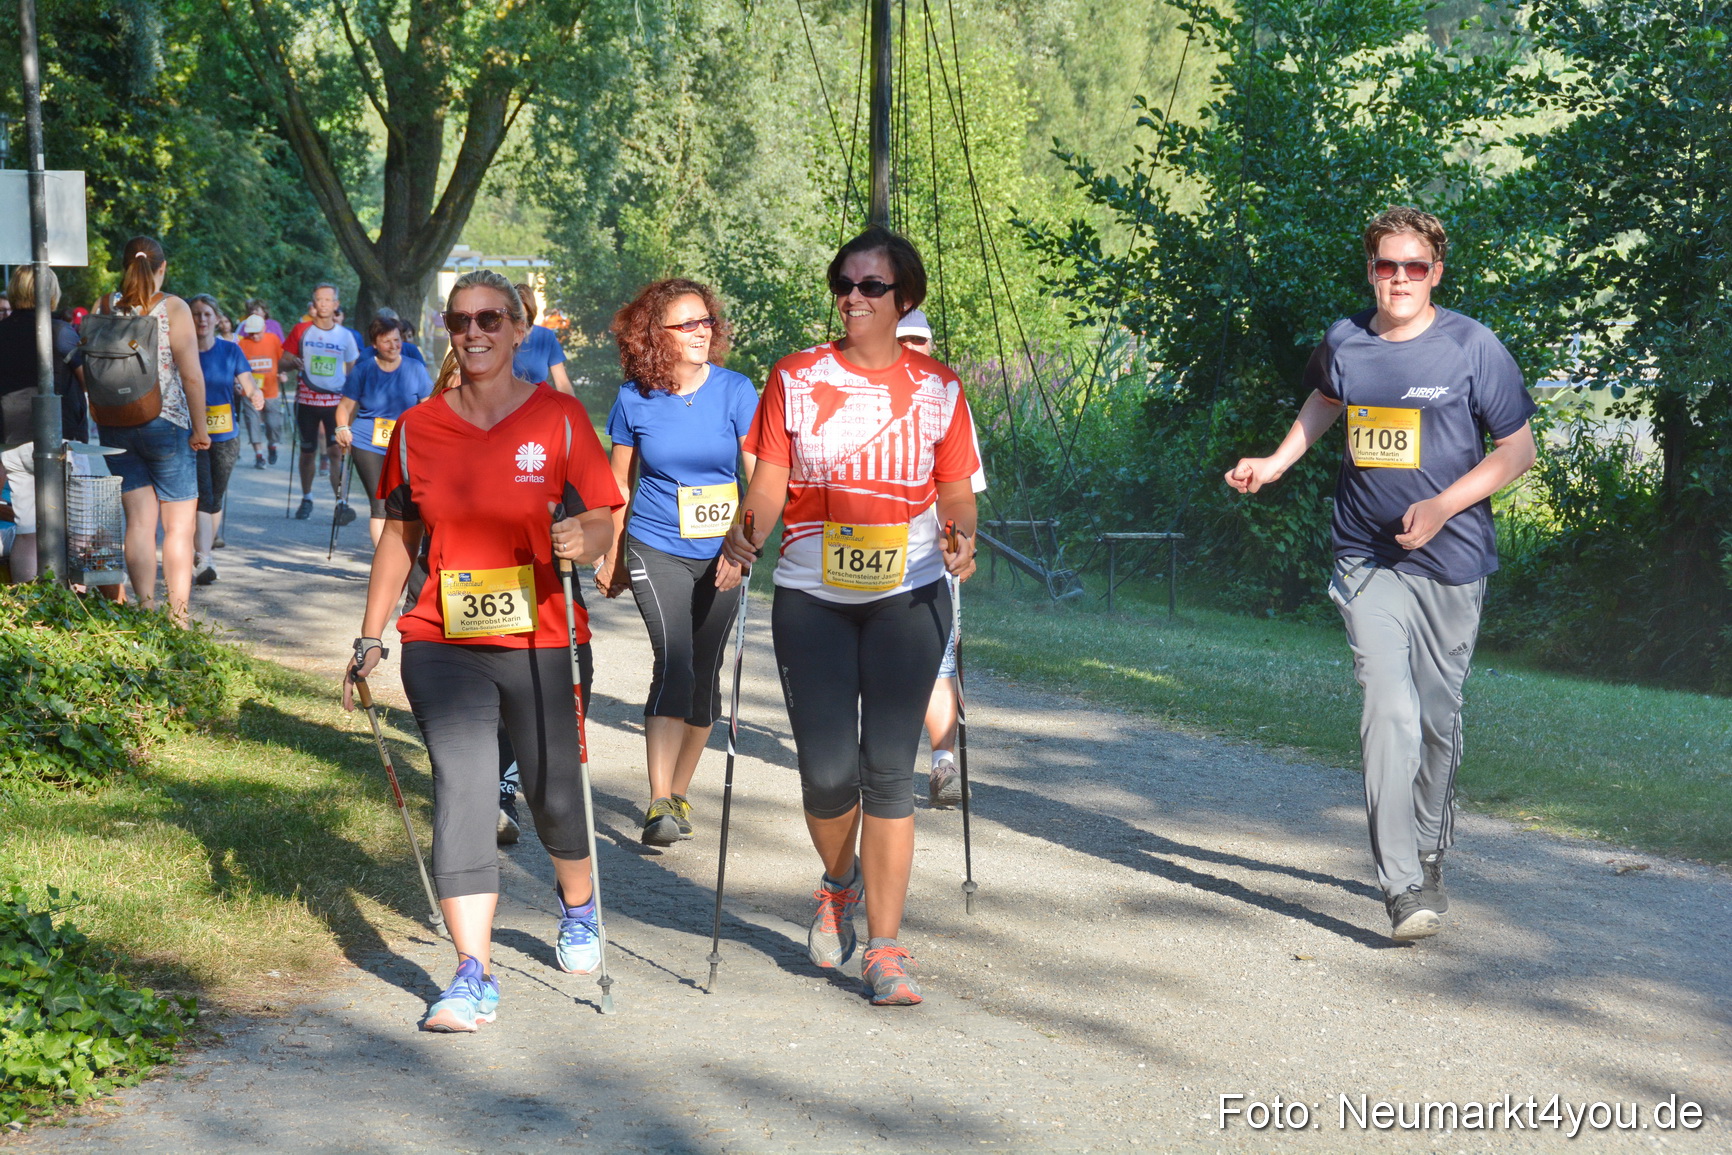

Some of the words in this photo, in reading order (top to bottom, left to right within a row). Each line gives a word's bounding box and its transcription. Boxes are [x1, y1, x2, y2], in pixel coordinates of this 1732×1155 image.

[206, 415, 226, 426] 673
[1353, 428, 1408, 451] 1108
[514, 473, 545, 483] caritas
[695, 502, 730, 523] 662
[834, 547, 898, 573] 1847
[827, 569, 880, 580] Kerschensteiner
[462, 592, 515, 618] 363
